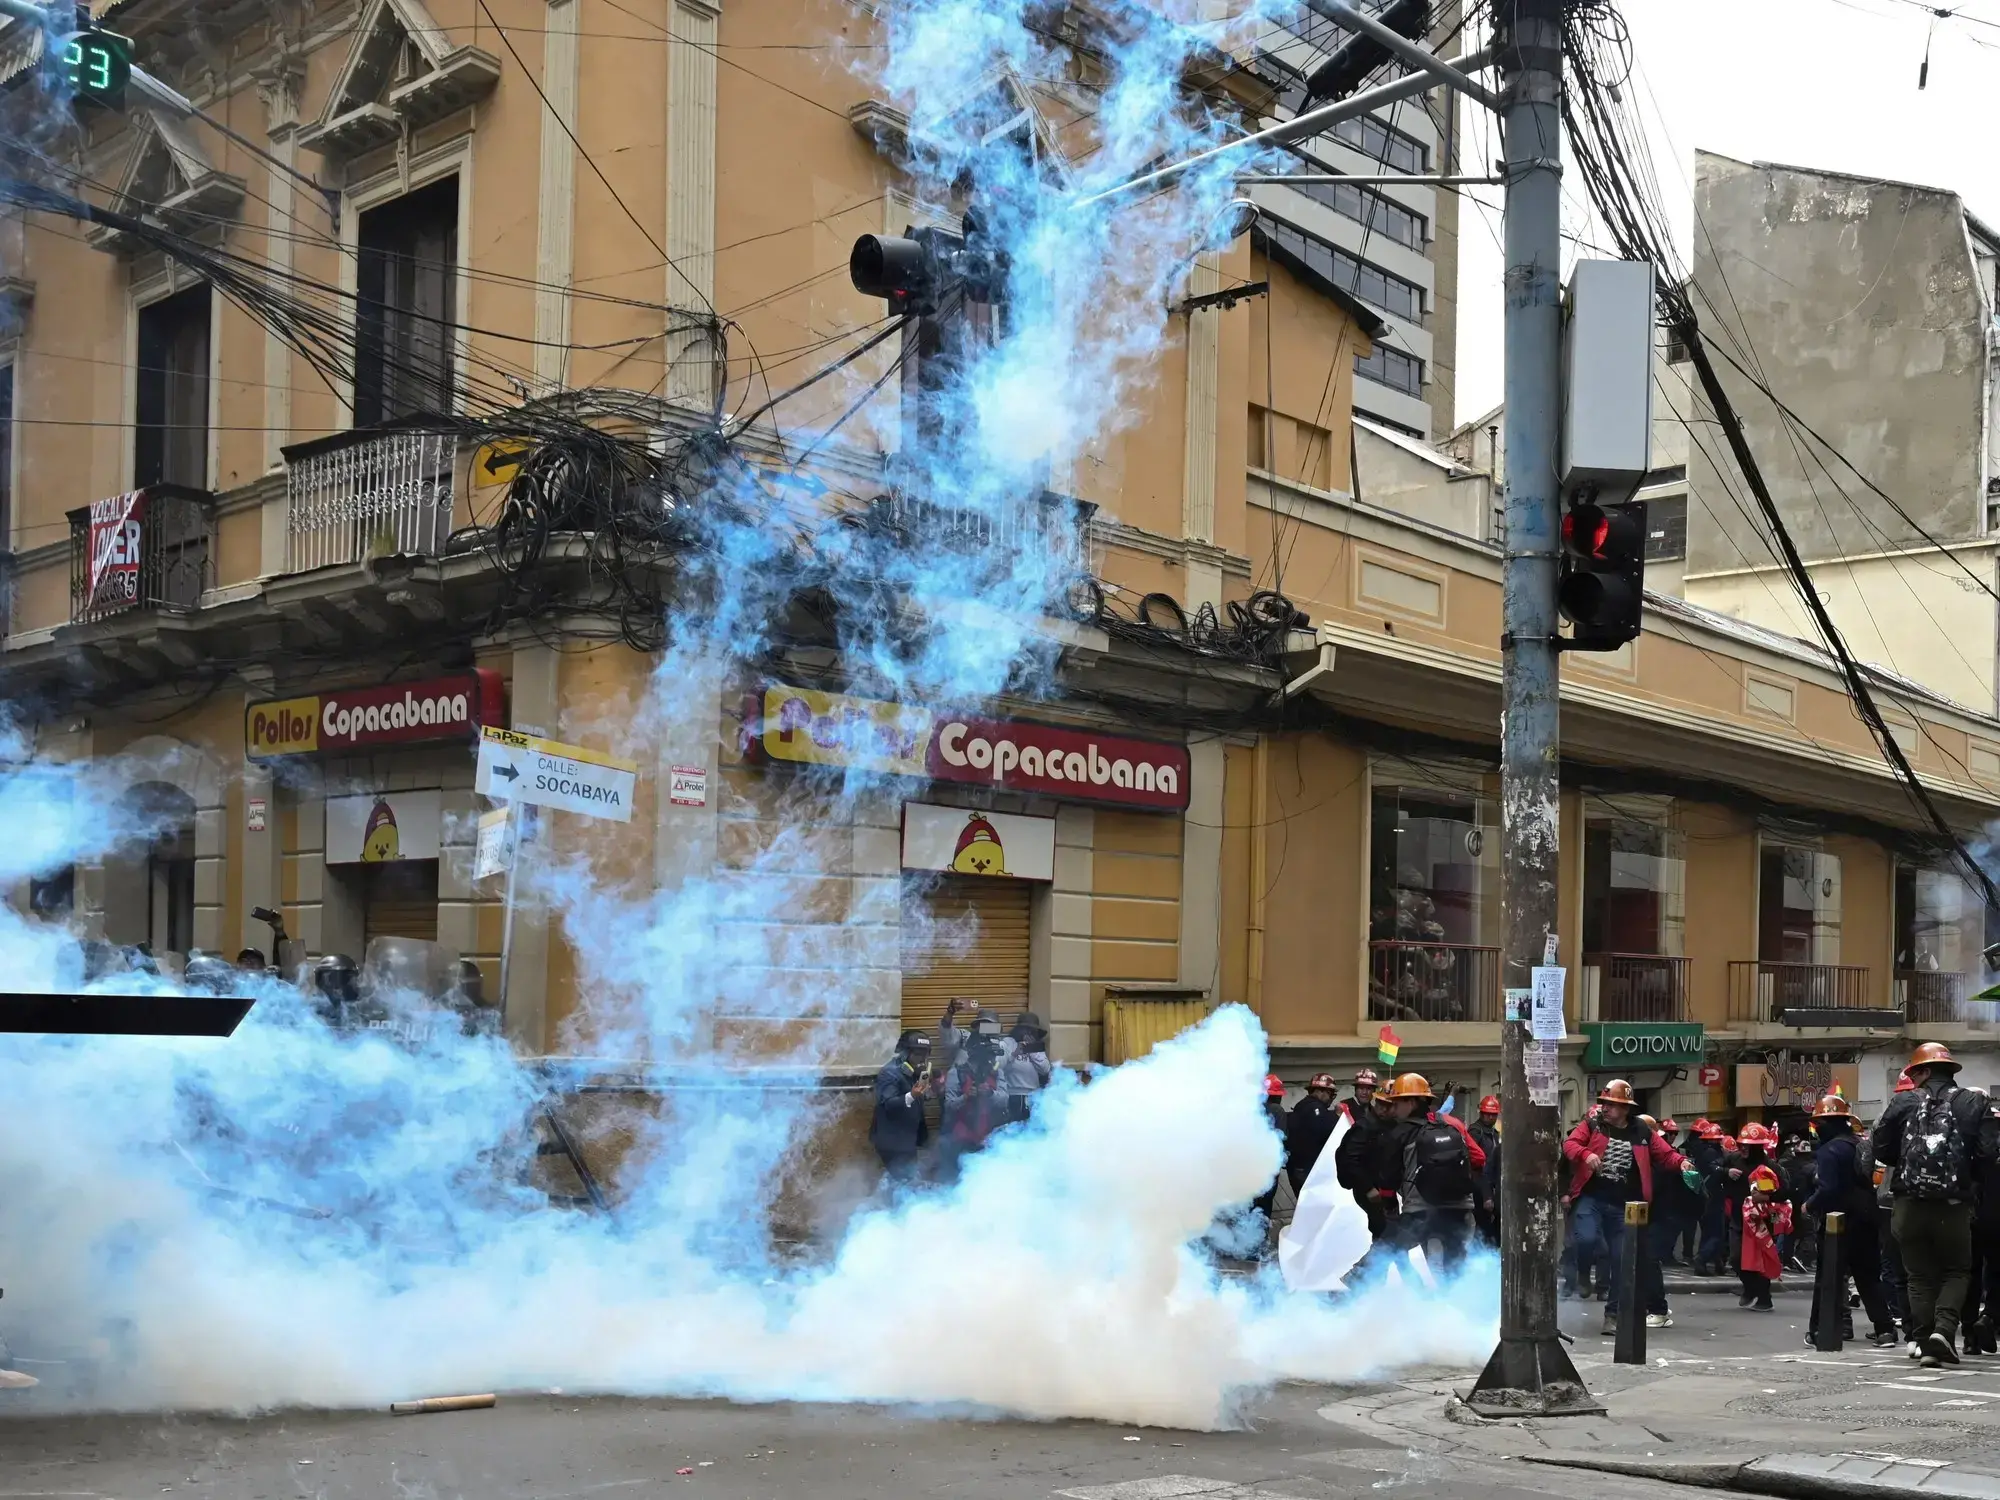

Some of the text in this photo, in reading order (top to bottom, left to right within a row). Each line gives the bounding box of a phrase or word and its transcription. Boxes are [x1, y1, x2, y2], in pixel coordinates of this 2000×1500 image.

[253, 691, 467, 745] Pollos Copacabana
[538, 757, 578, 776] CALLE:
[939, 722, 1178, 794] Copacabana
[535, 774, 620, 806] SOCABAYA
[1611, 1035, 1702, 1054] COTTON VIU
